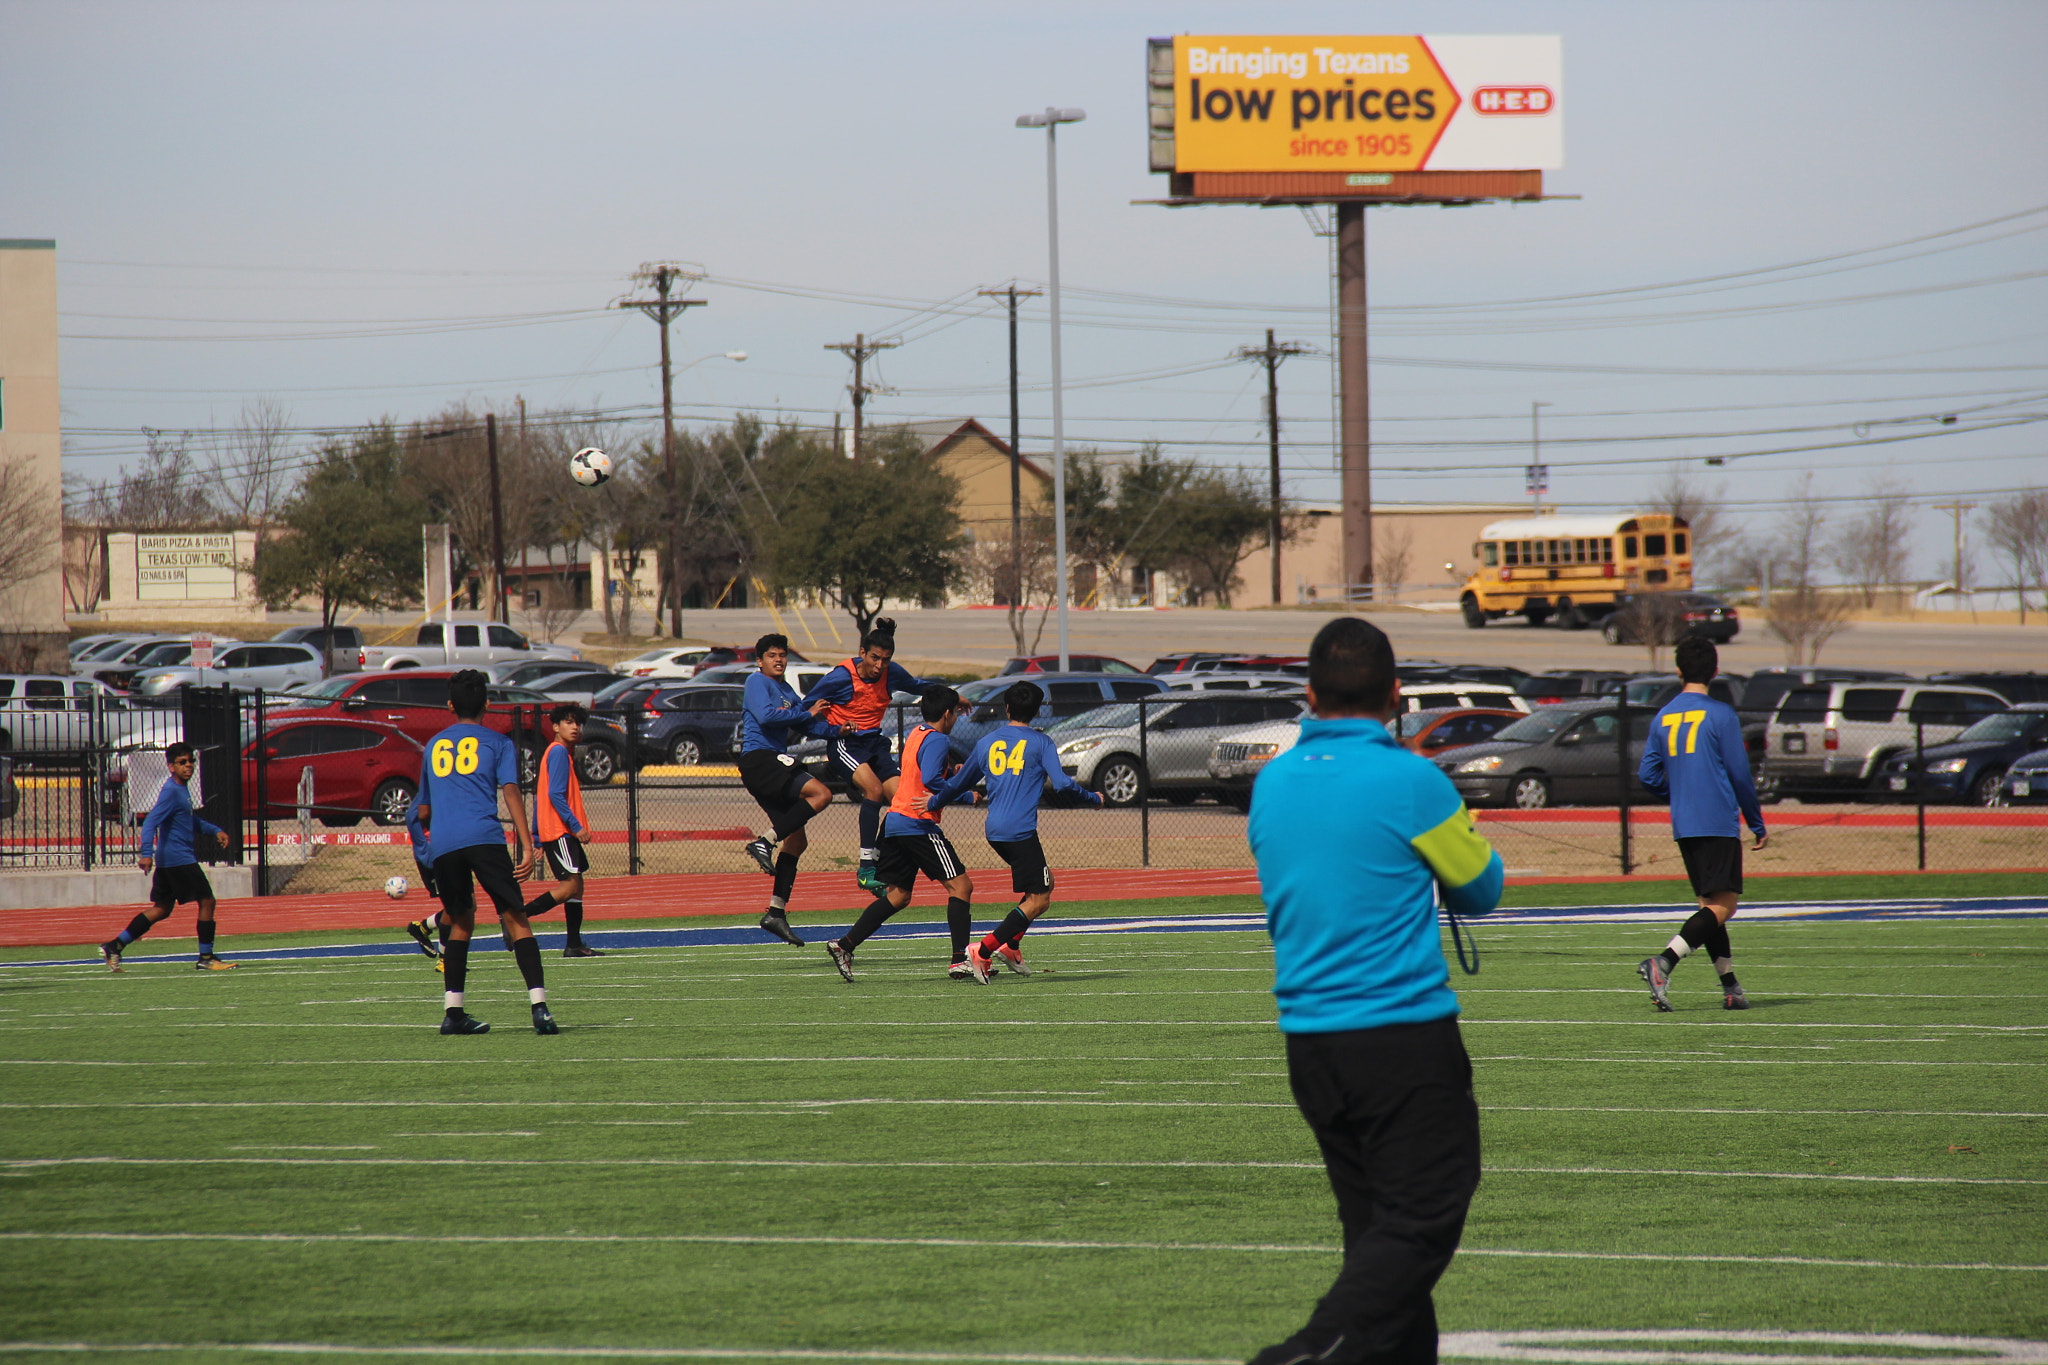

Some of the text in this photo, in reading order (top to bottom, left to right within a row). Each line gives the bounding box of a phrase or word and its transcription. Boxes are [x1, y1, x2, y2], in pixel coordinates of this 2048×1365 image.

[1188, 47, 1410, 79] Bringing Texans
[1190, 78, 1436, 130] low prices
[1289, 134, 1412, 157] since 1905
[141, 537, 230, 549] BARIS PIZZA & PASTA
[148, 553, 226, 566] TEXAS LOW-T MD
[149, 571, 167, 580] NAILS
[167, 571, 172, 580] &
[173, 570, 185, 580] SPA
[1661, 709, 1707, 758] 77
[431, 736, 479, 778] 68
[776, 753, 795, 767] 8
[987, 739, 1028, 777] 64
[276, 834, 298, 845] FIRE
[337, 834, 350, 844] NO
[354, 833, 391, 844] PARKING
